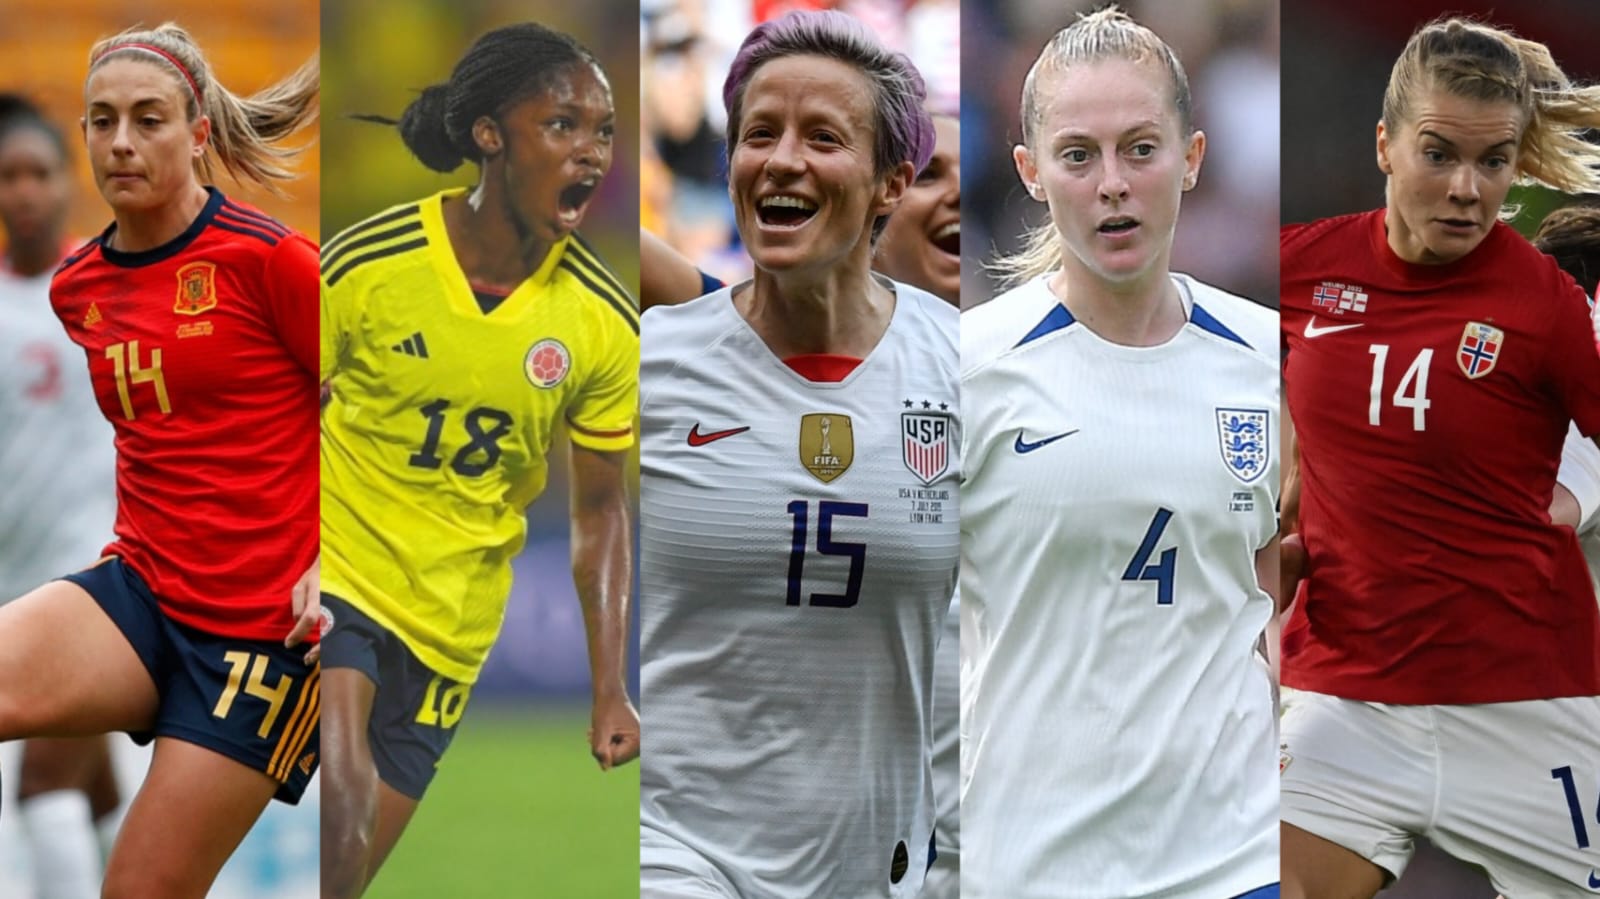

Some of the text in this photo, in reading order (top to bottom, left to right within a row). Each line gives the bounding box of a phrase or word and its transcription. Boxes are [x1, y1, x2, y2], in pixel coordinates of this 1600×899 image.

[105, 340, 171, 421] 14
[1368, 343, 1434, 431] 14
[408, 398, 514, 477] 18
[814, 456, 839, 465] FIFA
[906, 418, 945, 444] USA
[785, 500, 869, 609] 15
[1121, 507, 1178, 605] 4
[212, 650, 293, 739] 14
[1550, 765, 1600, 849] 1
